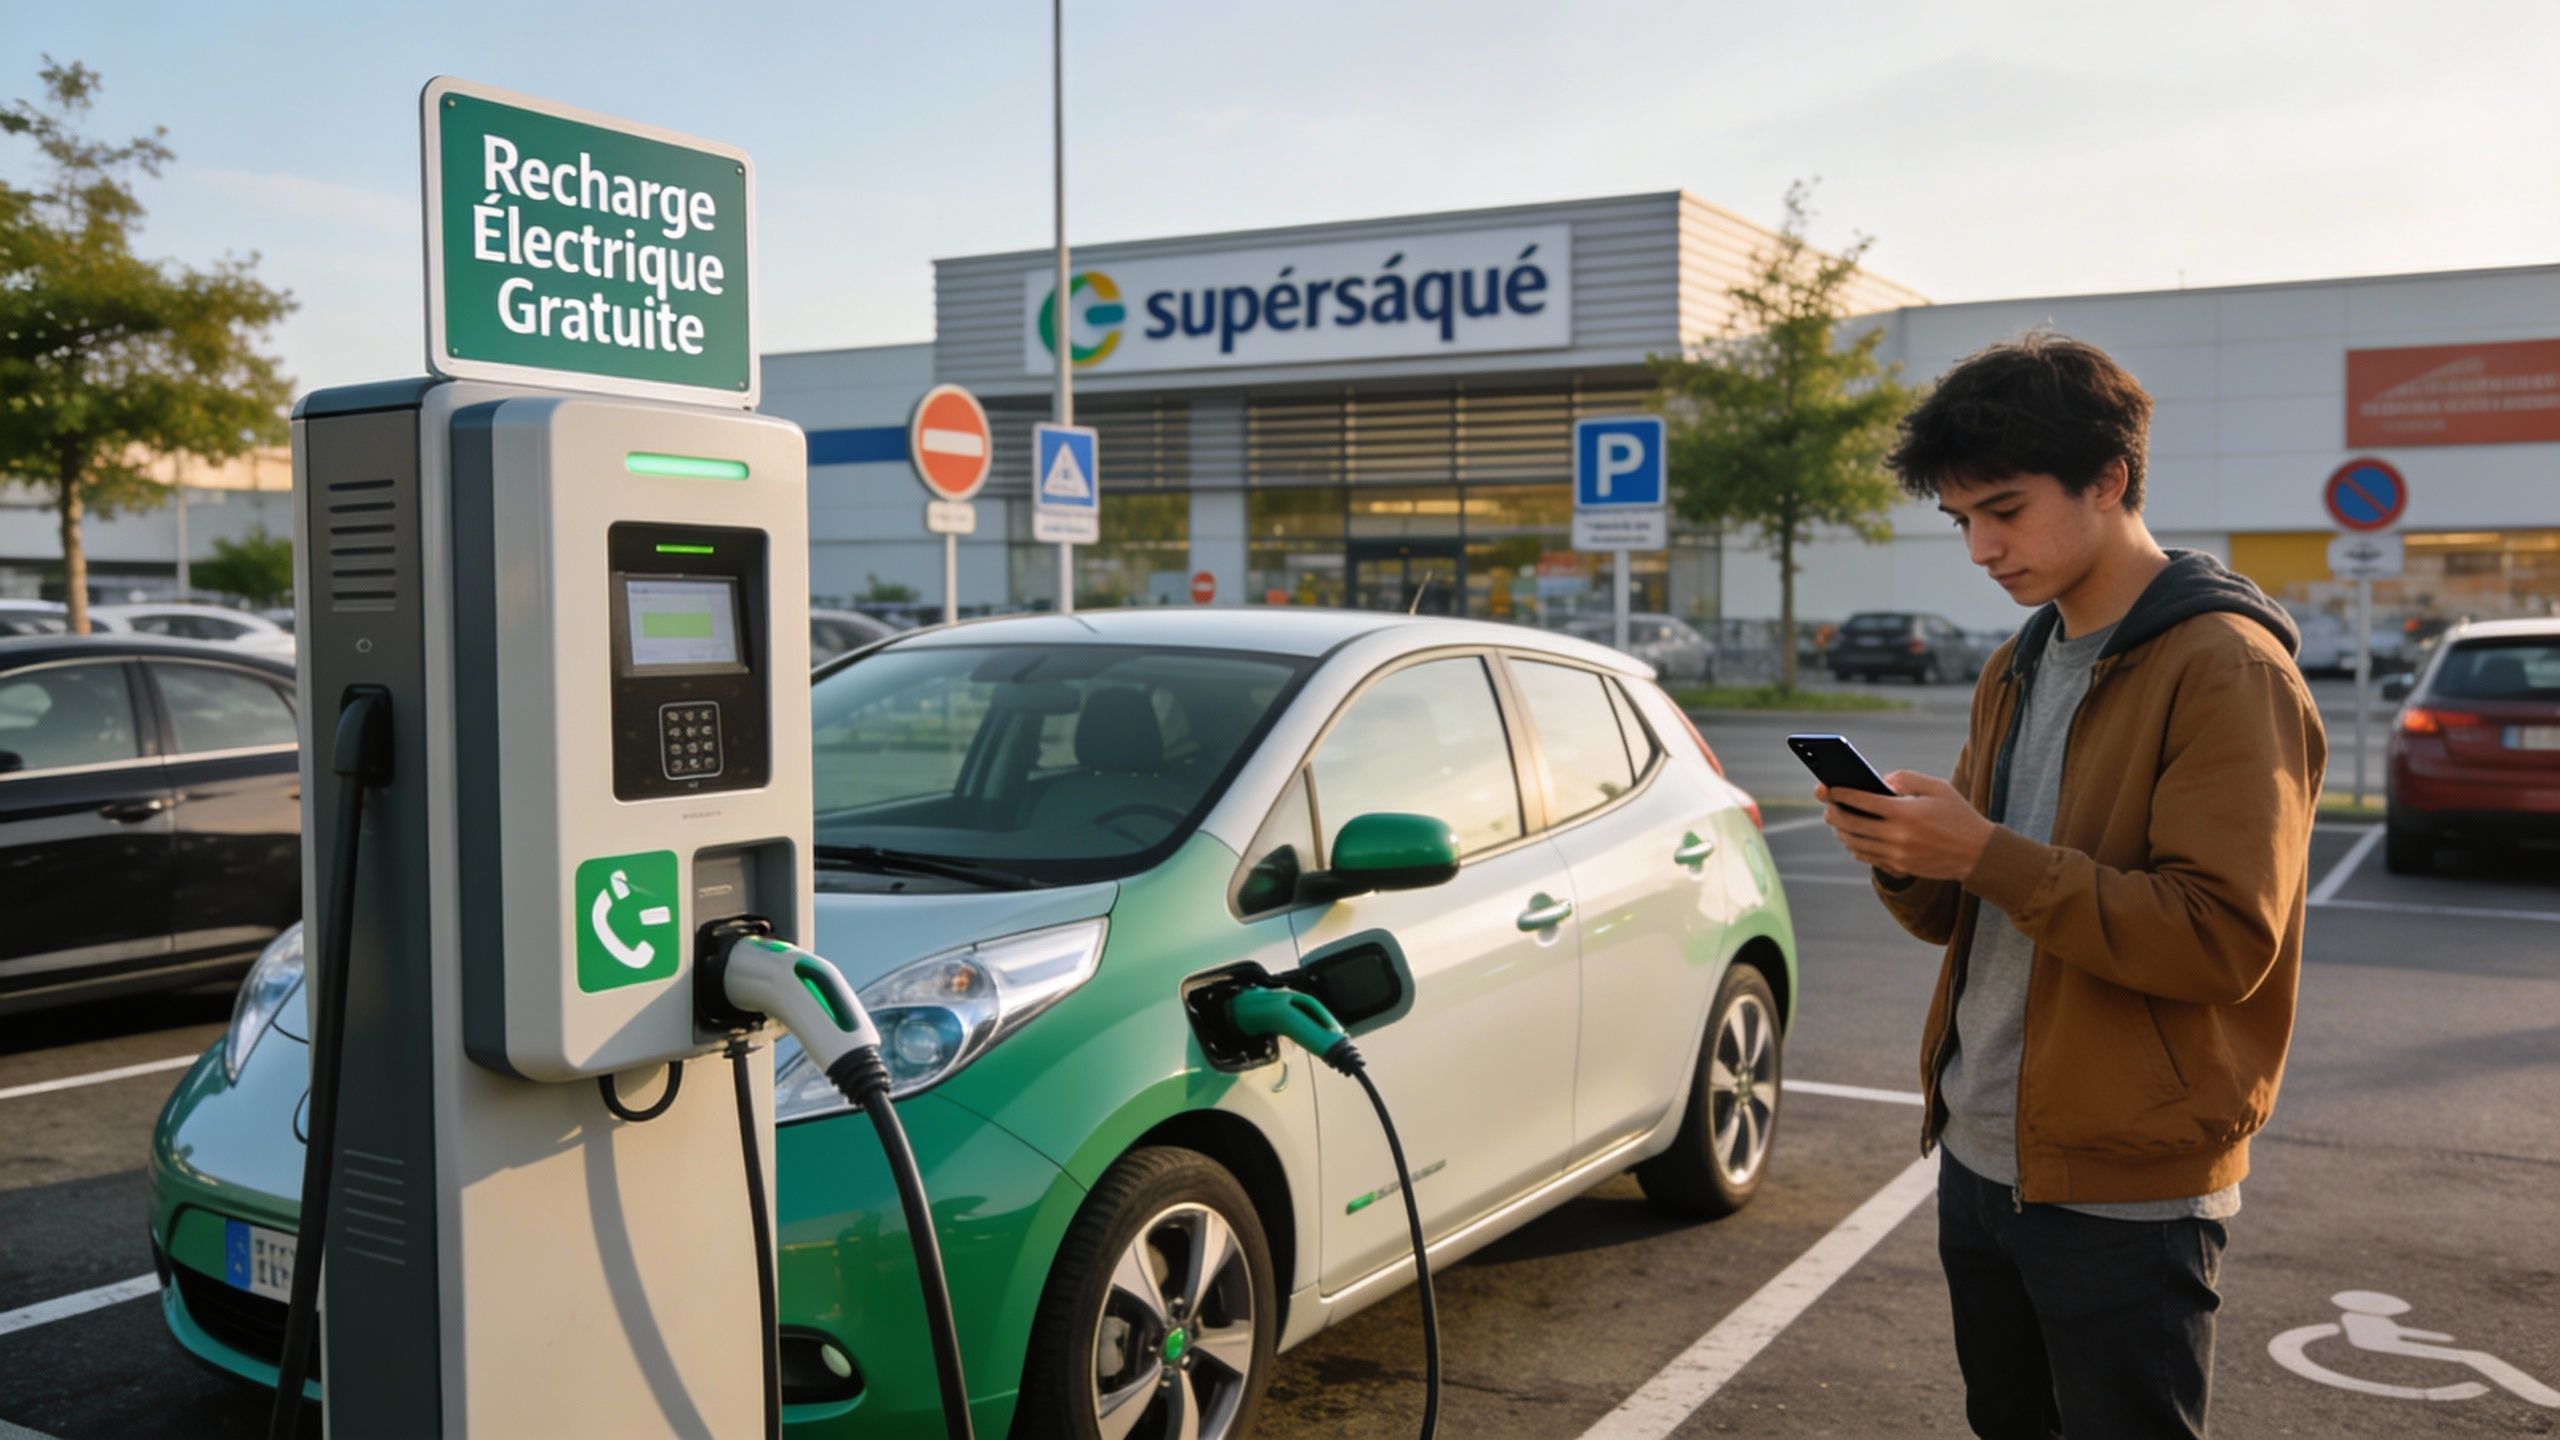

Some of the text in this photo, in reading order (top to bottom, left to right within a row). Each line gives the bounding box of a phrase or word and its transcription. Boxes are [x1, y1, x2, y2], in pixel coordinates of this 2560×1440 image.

[483, 133, 716, 240] Recharge
[473, 192, 725, 301] Électrique
[1144, 242, 1550, 355] supérsáqué
[497, 277, 705, 355] Gratuite
[1597, 433, 1645, 496] P
